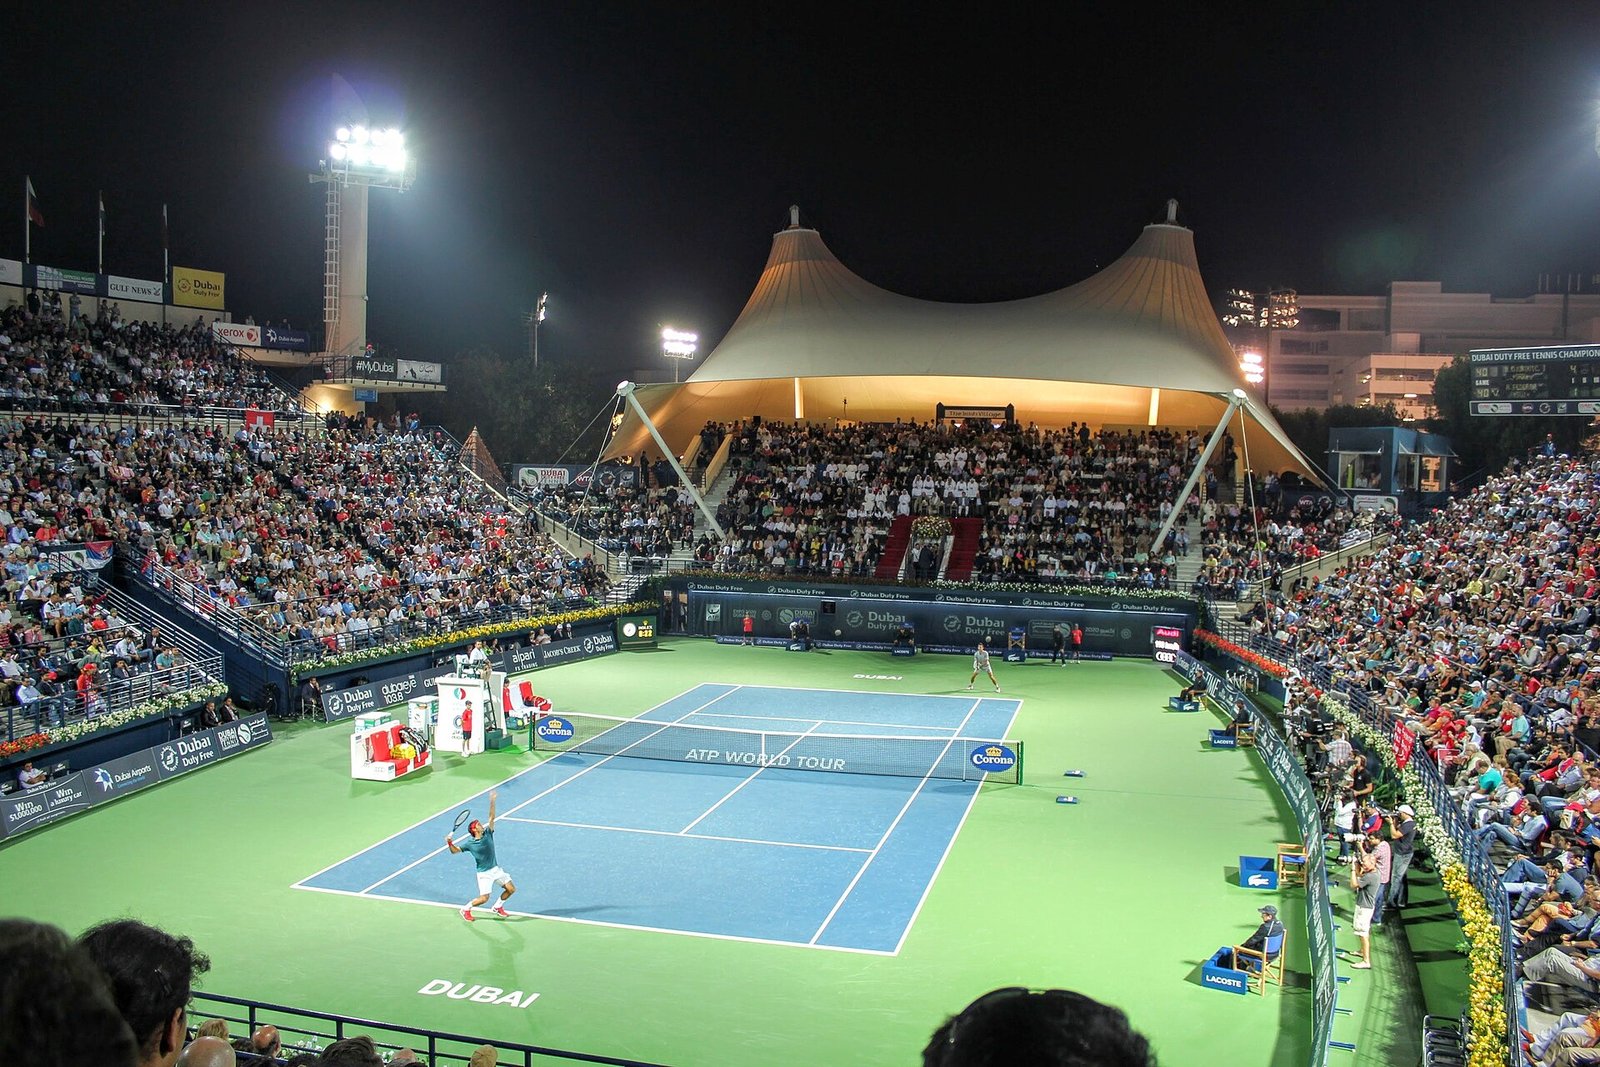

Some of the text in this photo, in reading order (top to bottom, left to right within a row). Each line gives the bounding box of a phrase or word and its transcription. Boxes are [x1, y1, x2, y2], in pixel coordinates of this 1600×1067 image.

[110, 283, 152, 295] GULF NEWS
[193, 280, 221, 291] Dubai
[218, 328, 244, 338] xerox
[1471, 349, 1600, 362] DUBAI DUTY FREE TENNIS CHAMPION
[356, 361, 395, 374] #MyDubai
[868, 611, 906, 623] Dubai
[966, 615, 1005, 628] Dubai
[867, 622, 887, 631] Duty
[965, 627, 1005, 636] Duty Free
[1156, 628, 1179, 636] Audi
[593, 635, 613, 645] Dubai
[512, 648, 536, 665] alpari
[423, 677, 436, 688] GUL
[853, 673, 903, 681] DUBAI
[343, 689, 373, 704] Dubai
[383, 691, 404, 705] 103.8
[346, 701, 375, 713] Duty Free
[537, 726, 573, 737] Corona
[177, 736, 211, 756] Dubai
[182, 750, 214, 767] Duty Free
[685, 748, 846, 770] ATP WORLD TOUR
[972, 753, 1014, 765] Corona
[114, 772, 131, 783] Dubai
[131, 765, 152, 777] Airports
[55, 788, 74, 798] Win
[55, 795, 73, 805] luxury
[73, 791, 83, 799] car
[14, 801, 34, 812] Win
[9, 804, 43, 822] $1,000,000
[1205, 974, 1242, 988] LACOSTE
[418, 979, 541, 1008] DUBAI
